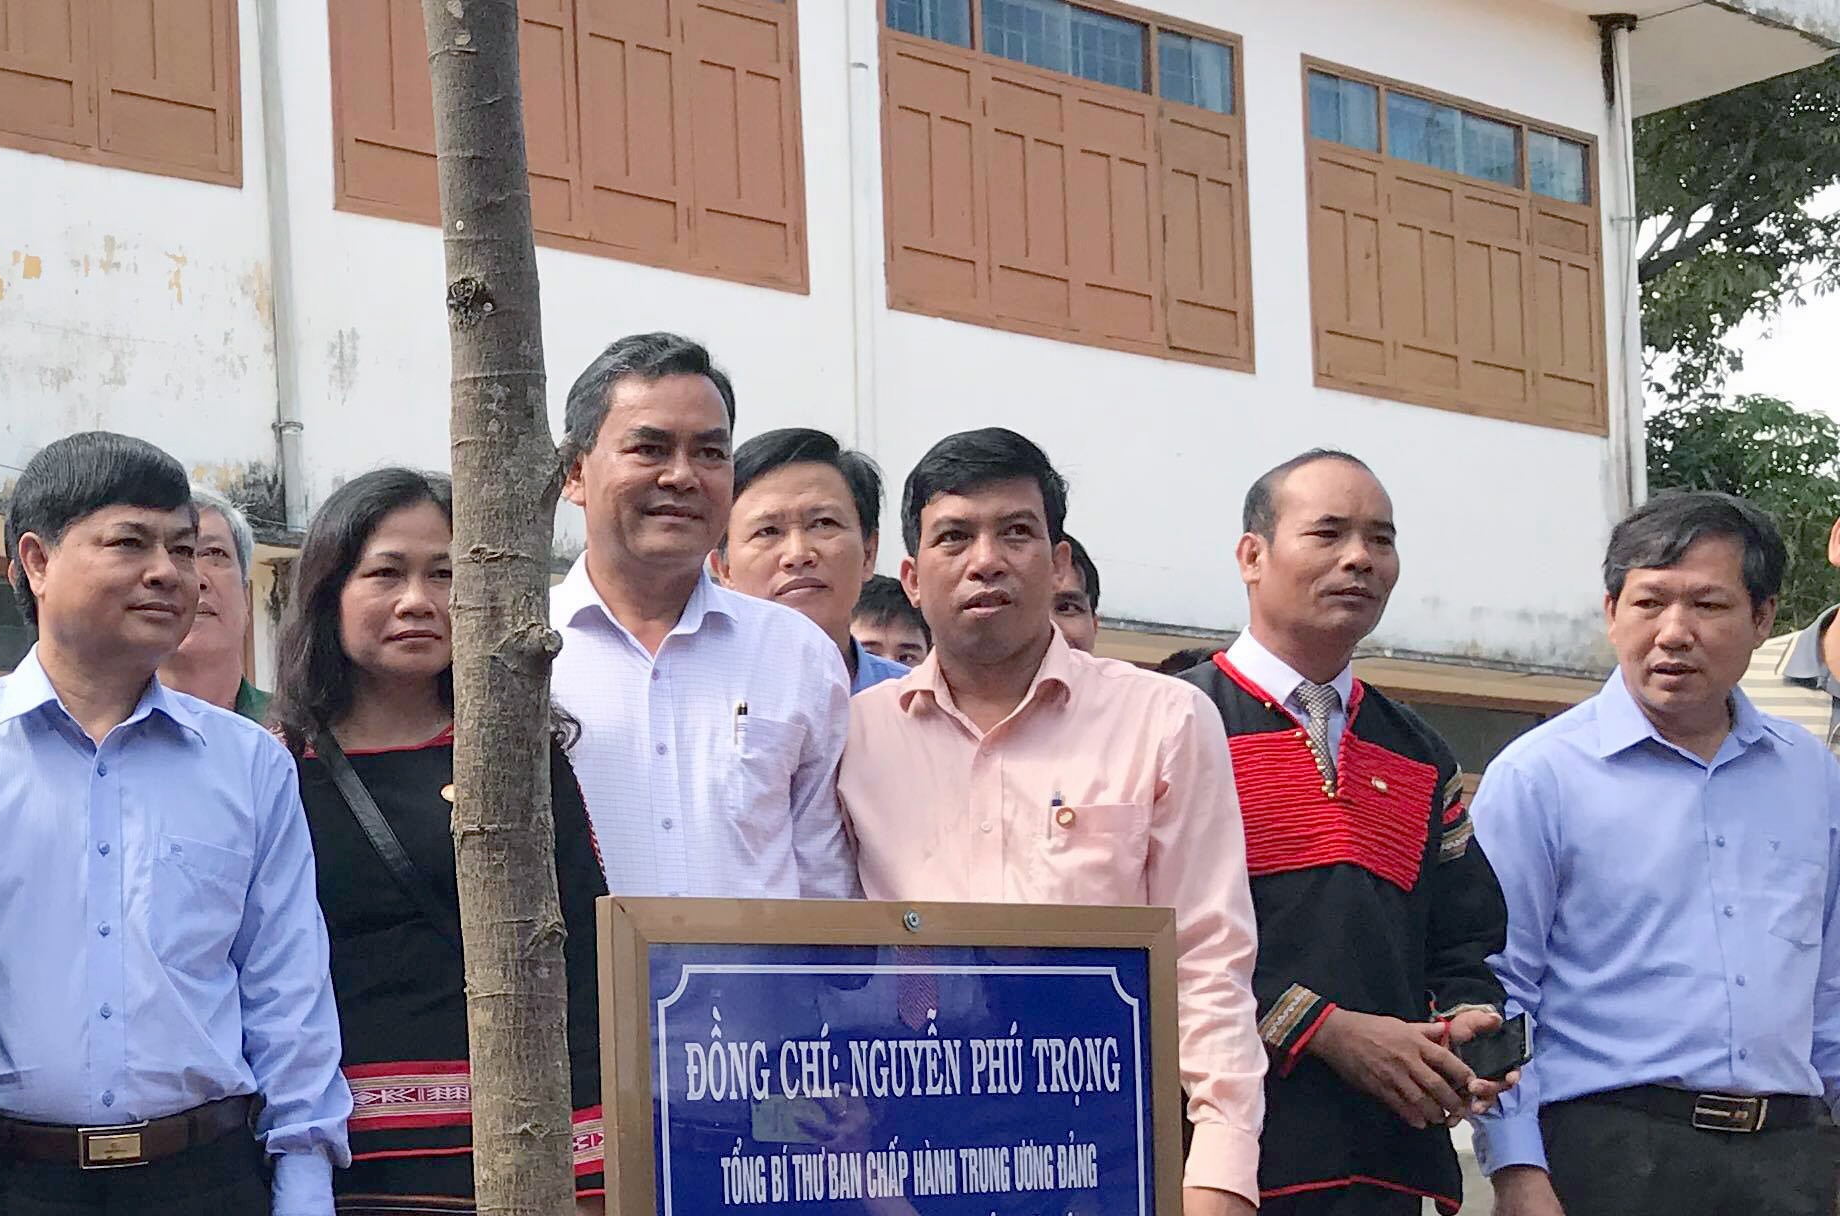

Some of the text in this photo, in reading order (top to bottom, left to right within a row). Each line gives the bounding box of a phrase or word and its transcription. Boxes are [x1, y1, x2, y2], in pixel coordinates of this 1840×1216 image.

[684, 1006, 1121, 1106] ĐỒNG CHÍ: NGUYỄN PHÚ TRỌNG
[720, 1130, 1098, 1205] TỔNG BÍ THƯ BAN CHẤP HÀNH TRUNG ƯƠNG ĐẢNG
